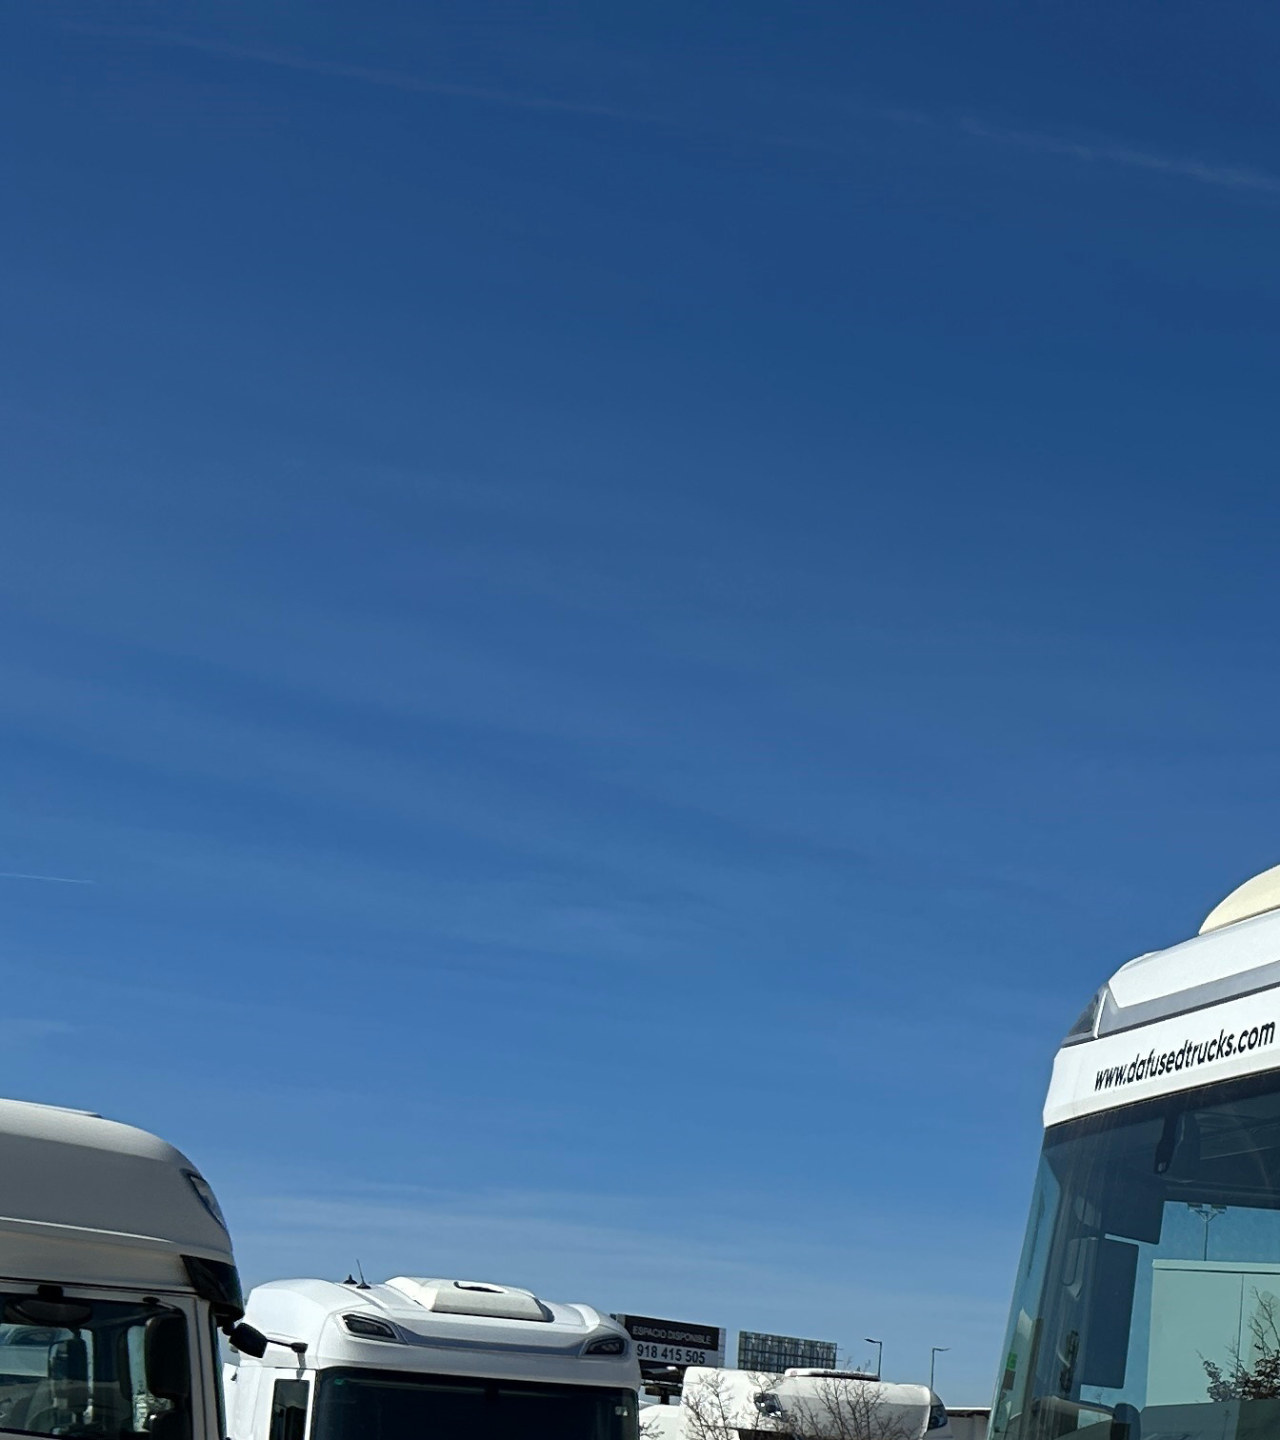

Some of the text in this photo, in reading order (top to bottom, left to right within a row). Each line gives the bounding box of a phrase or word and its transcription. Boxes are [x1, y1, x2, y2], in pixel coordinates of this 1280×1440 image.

[1094, 1020, 1276, 1092] www.dafusedtrucks.com
[632, 1324, 712, 1346] ESPACIO DISPONIBLE
[636, 1342, 706, 1365] 918 415 505
